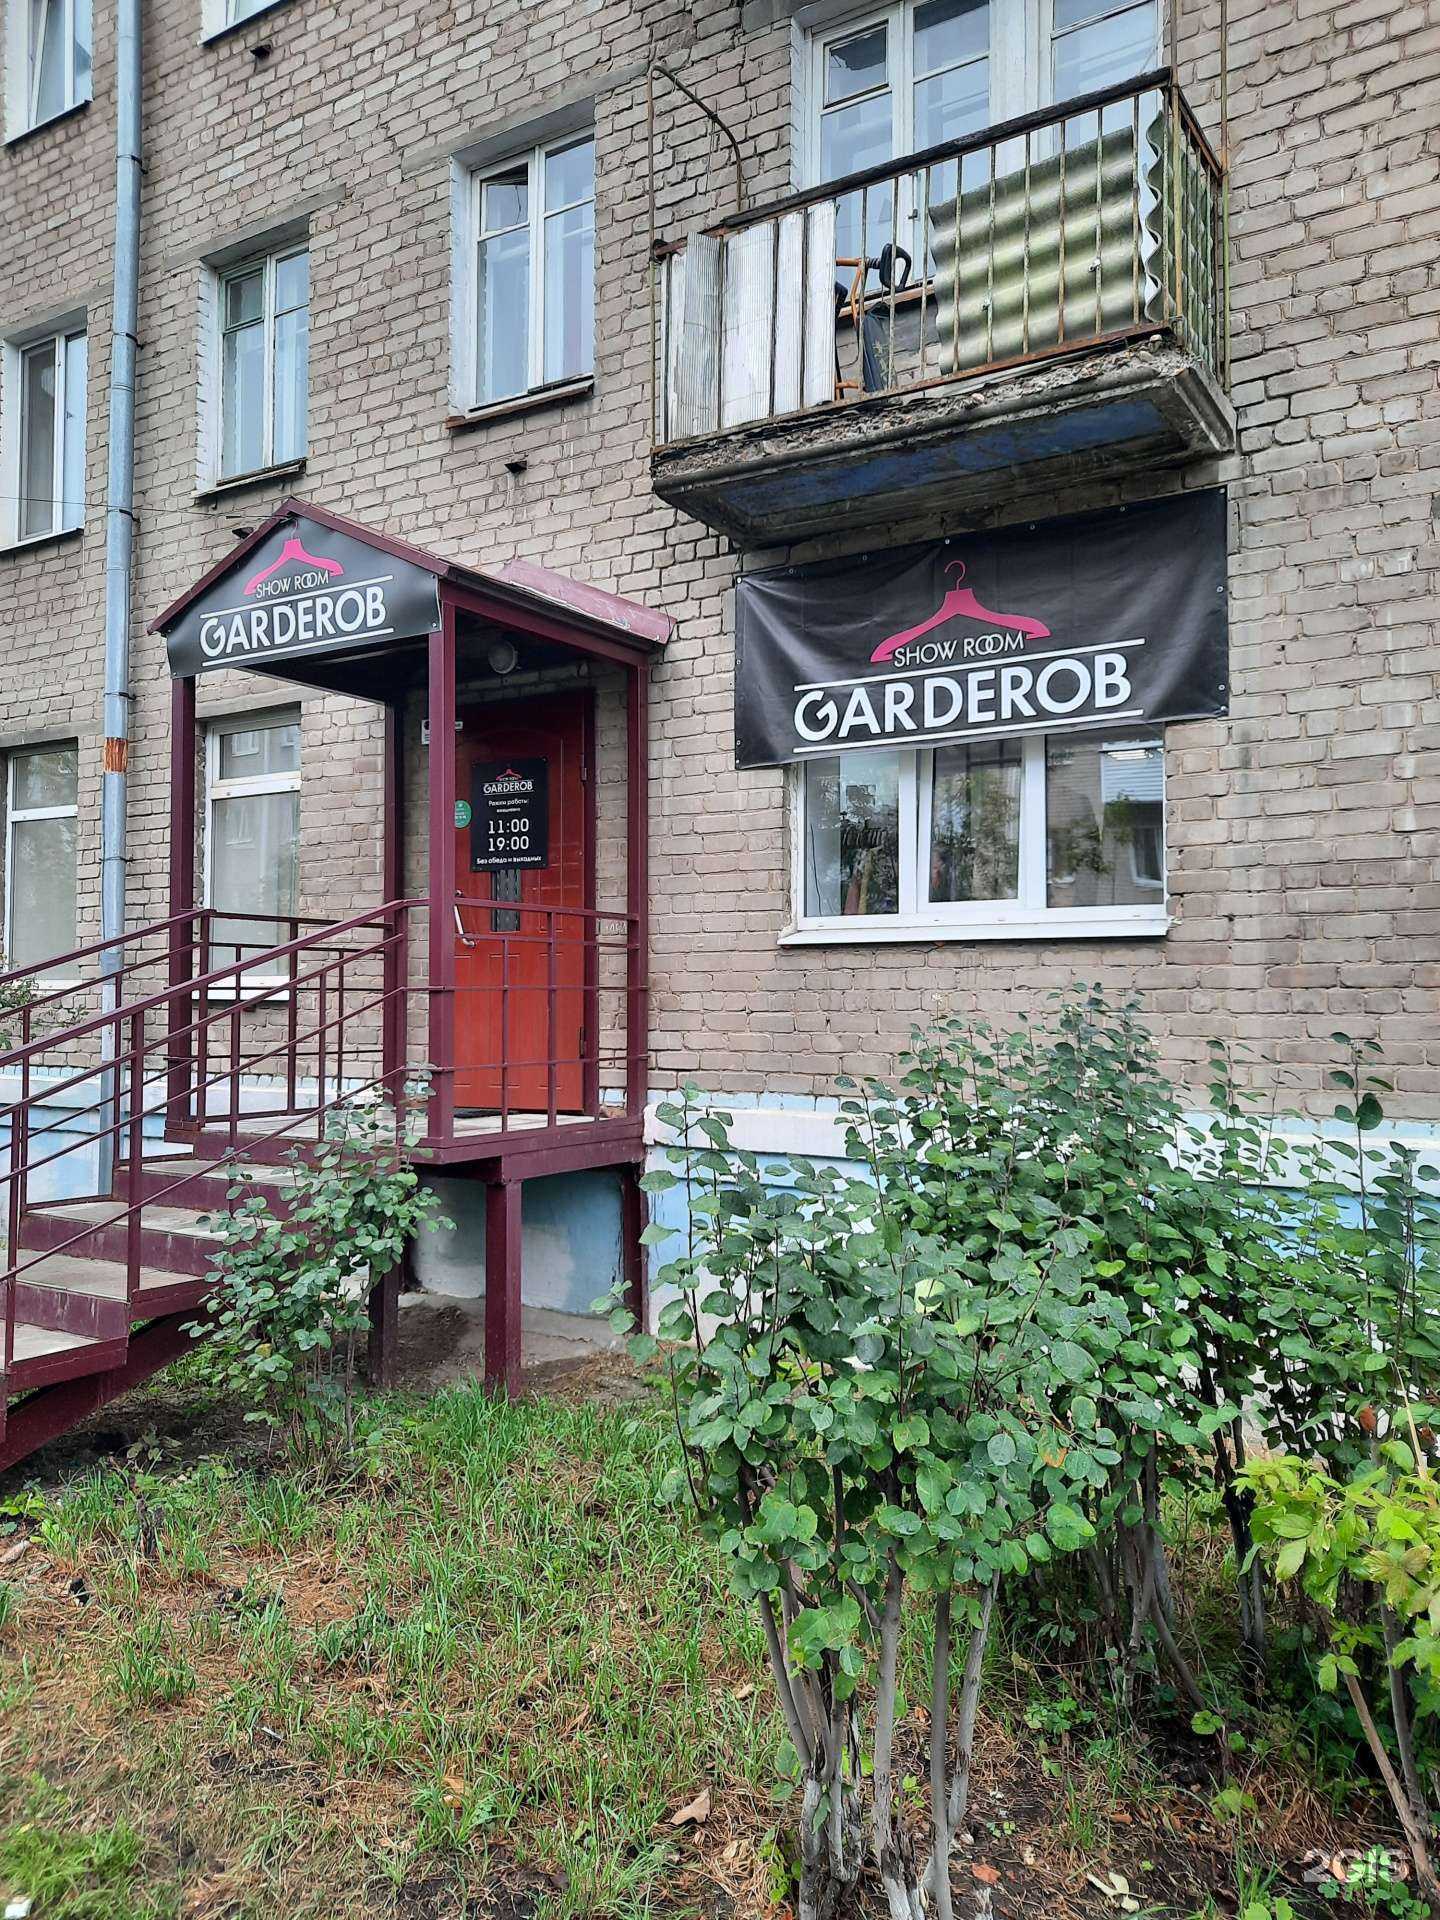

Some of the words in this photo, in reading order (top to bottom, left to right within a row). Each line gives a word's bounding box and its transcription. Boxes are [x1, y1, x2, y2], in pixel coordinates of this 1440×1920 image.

[256, 578, 291, 599] SHOW
[294, 570, 329, 590] ROOM
[200, 586, 387, 657] GARDEROB
[894, 639, 958, 668] SHOW
[964, 631, 1025, 658] ROOM
[794, 653, 1132, 742] GARDEROB
[483, 781, 533, 794] GARDEROB
[488, 818, 530, 834] 11:00
[488, 836, 530, 852] 19:00
[476, 857, 488, 865] Без
[488, 856, 507, 864] обеда
[513, 855, 542, 863] выходных
